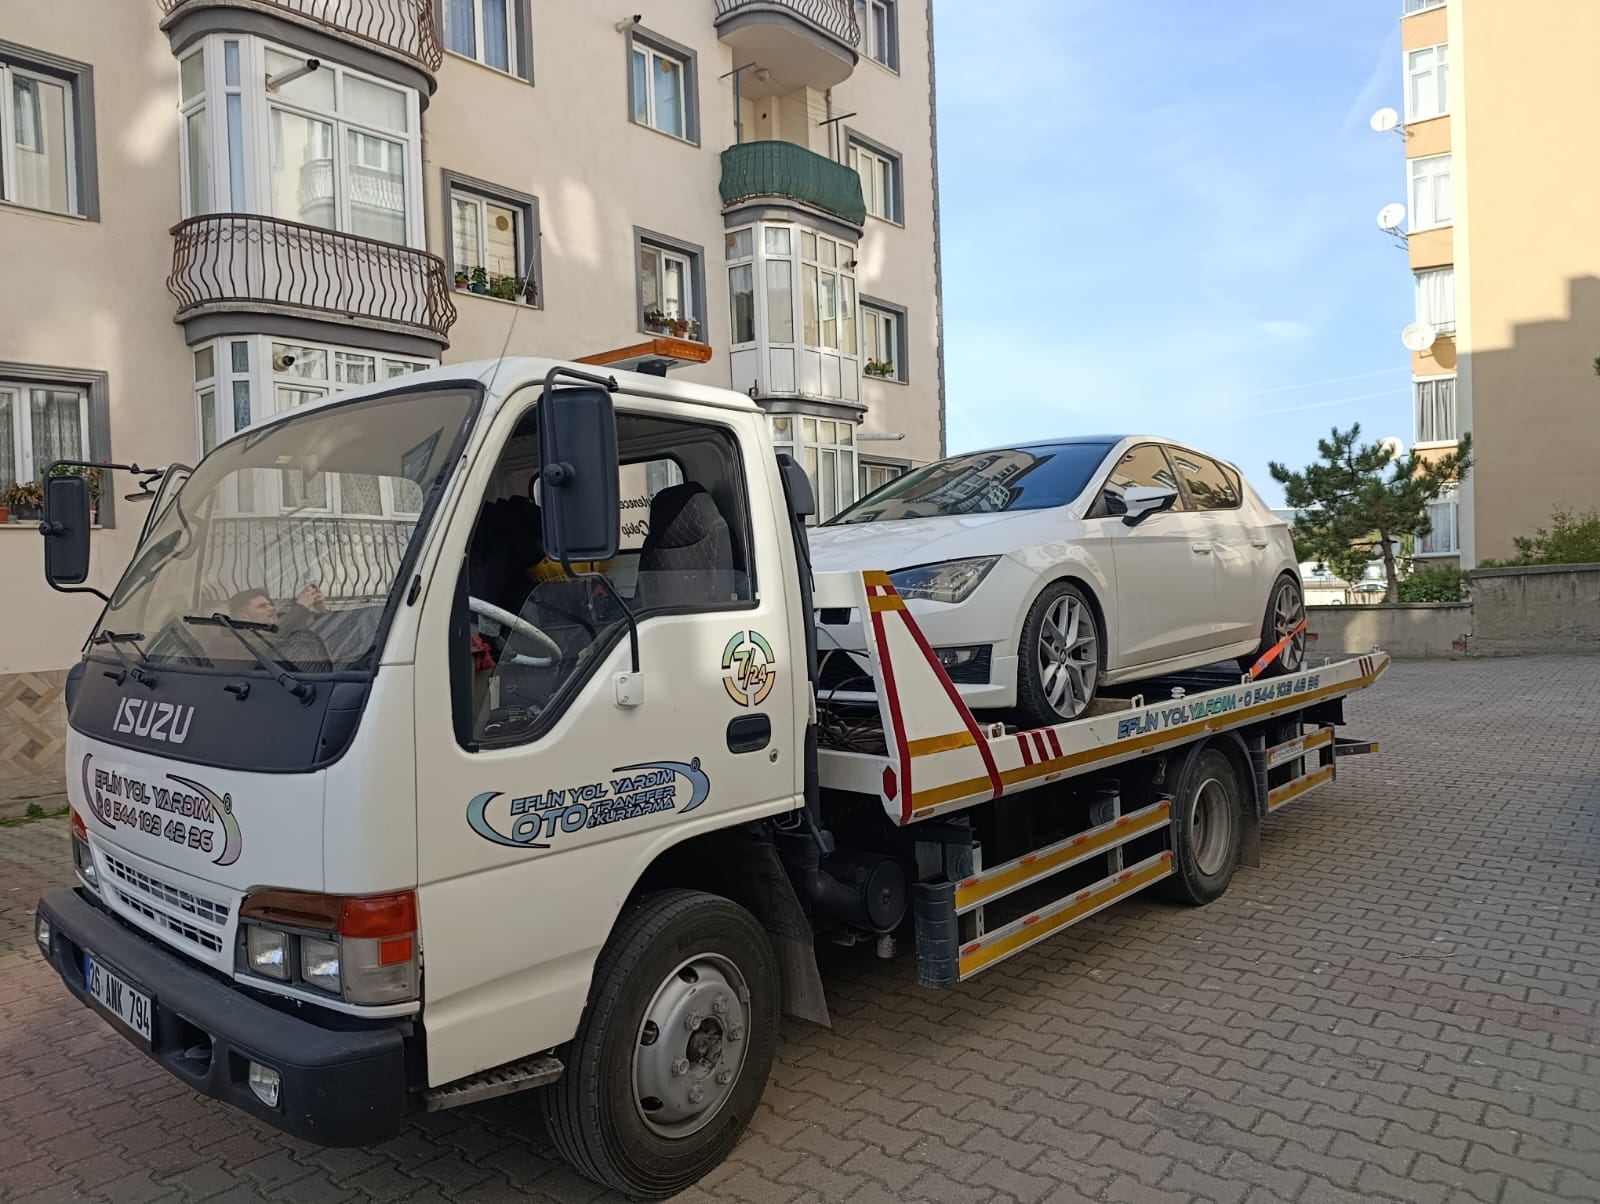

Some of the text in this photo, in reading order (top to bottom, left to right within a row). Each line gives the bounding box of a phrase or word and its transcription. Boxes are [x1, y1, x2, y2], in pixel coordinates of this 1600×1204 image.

[733, 647, 767, 691] 7/24
[113, 697, 194, 743] ISUZU
[1161, 706, 1190, 727] YOL
[123, 777, 151, 804] YOL
[152, 785, 215, 823] YARDIM
[567, 783, 608, 803] YOL
[610, 768, 676, 795] YARDIM
[589, 784, 676, 814] TRANSFER
[112, 801, 137, 828] 544
[139, 810, 162, 834] 103
[164, 819, 187, 845] 42
[188, 827, 214, 852] 26
[511, 804, 589, 843] OTO
[90, 962, 150, 1035] 26 ANK 794
